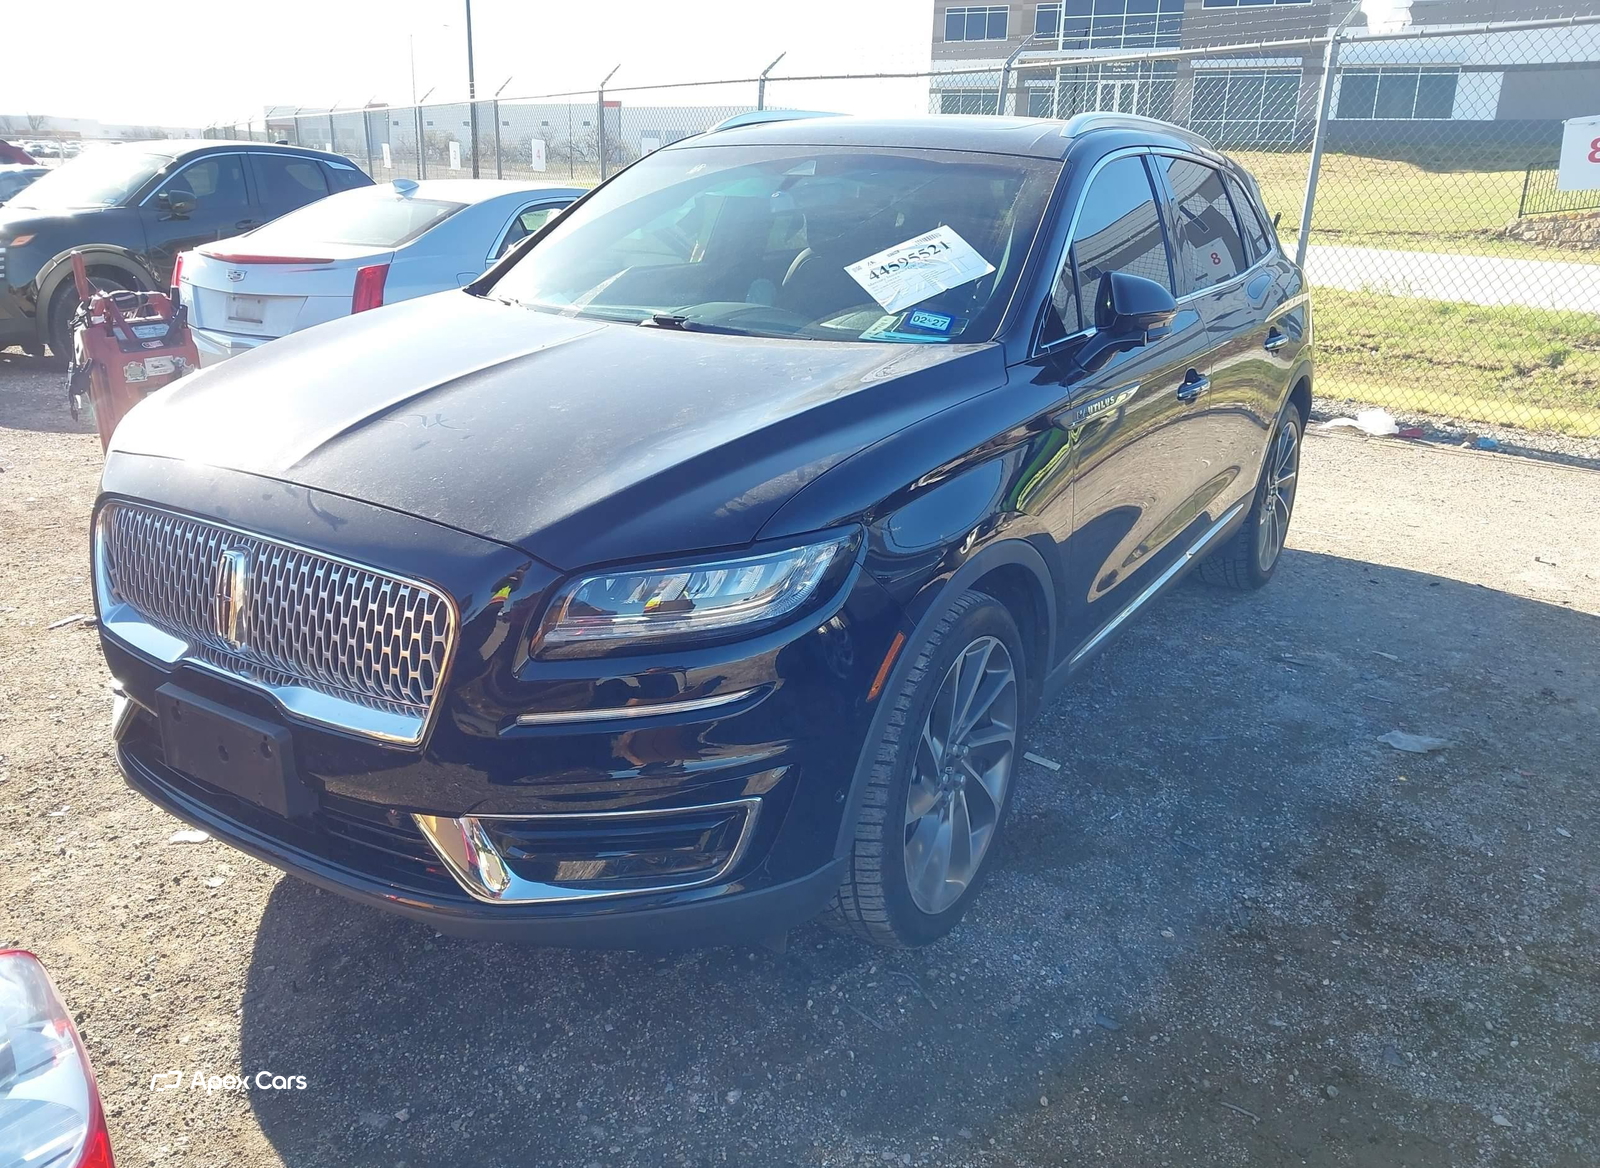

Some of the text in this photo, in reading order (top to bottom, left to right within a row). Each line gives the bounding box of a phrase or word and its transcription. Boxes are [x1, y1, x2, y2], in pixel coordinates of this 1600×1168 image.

[869, 241, 950, 280] 44595521
[912, 315, 928, 324] 02
[931, 318, 947, 328] 27
